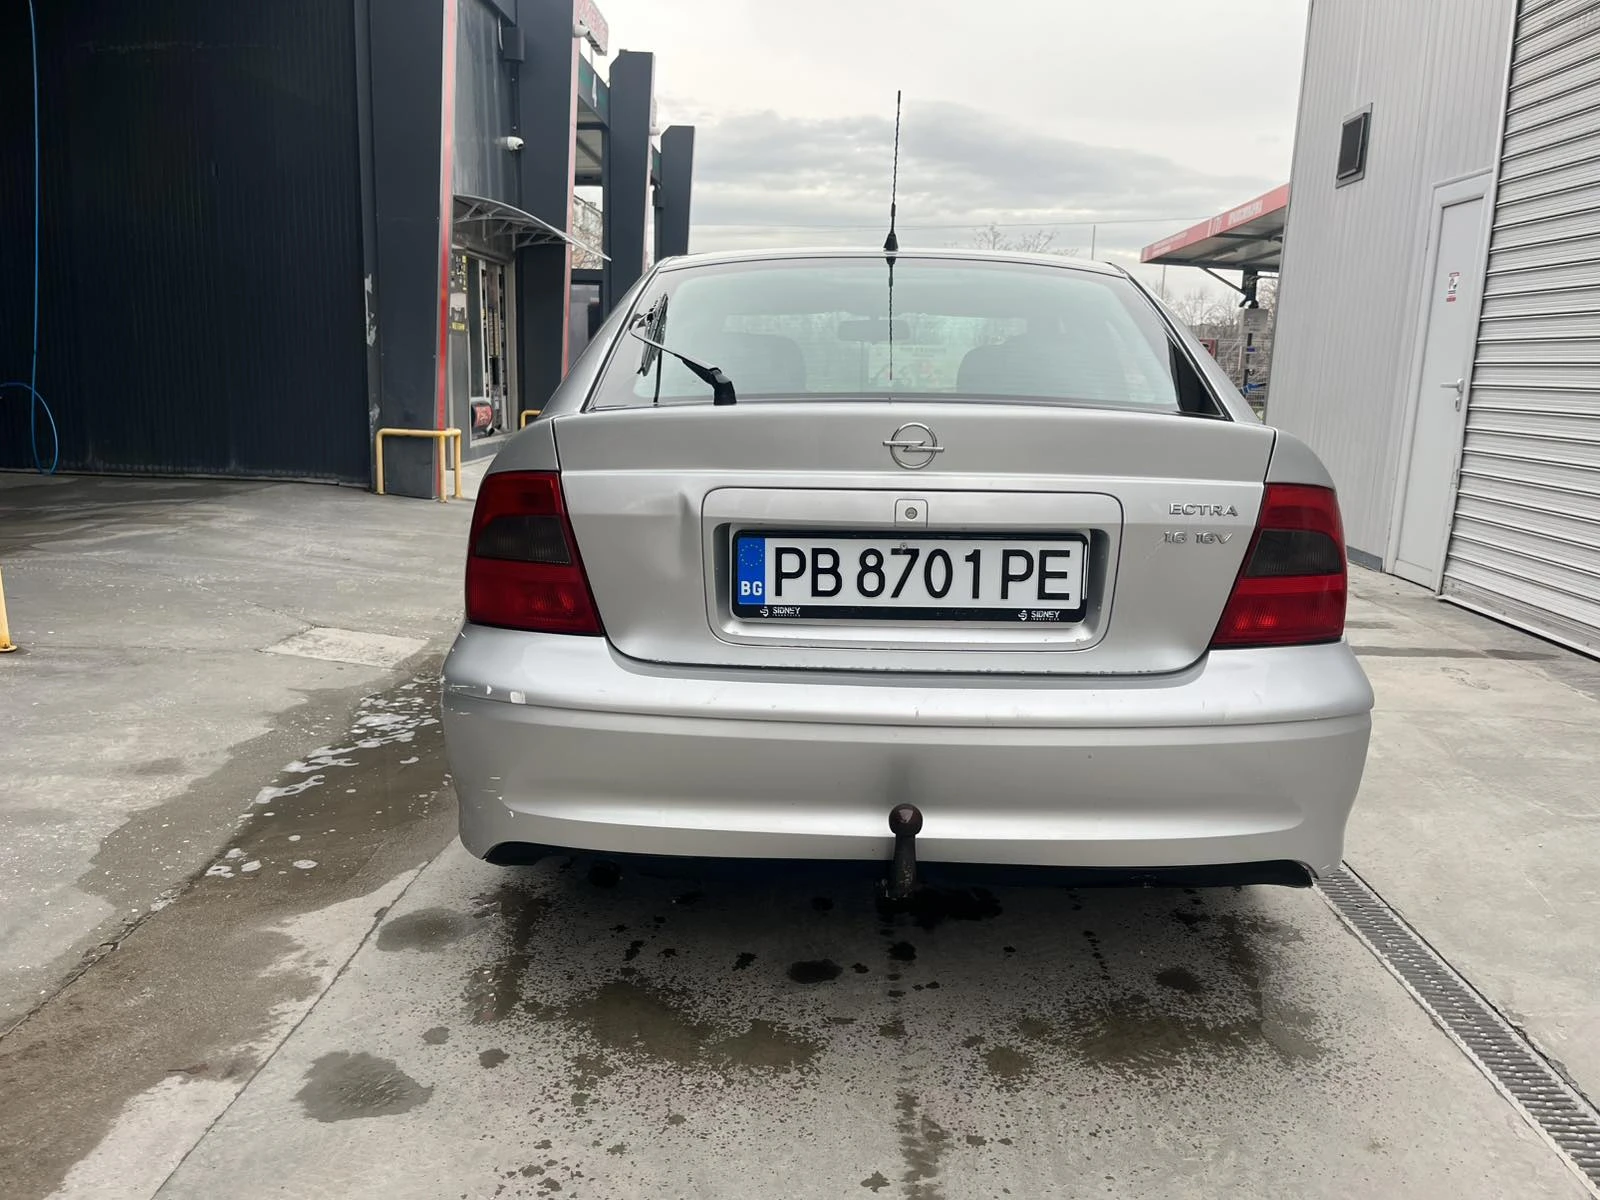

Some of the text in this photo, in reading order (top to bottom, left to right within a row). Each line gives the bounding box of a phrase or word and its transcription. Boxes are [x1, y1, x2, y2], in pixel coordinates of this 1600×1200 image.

[1168, 503, 1238, 517] ECTRA
[1195, 531, 1233, 545] 16V
[774, 547, 1071, 601] PB 8701 PE
[740, 580, 763, 597] BG
[772, 606, 801, 615] SIDNEY
[1030, 610, 1060, 618] SIDNEY
